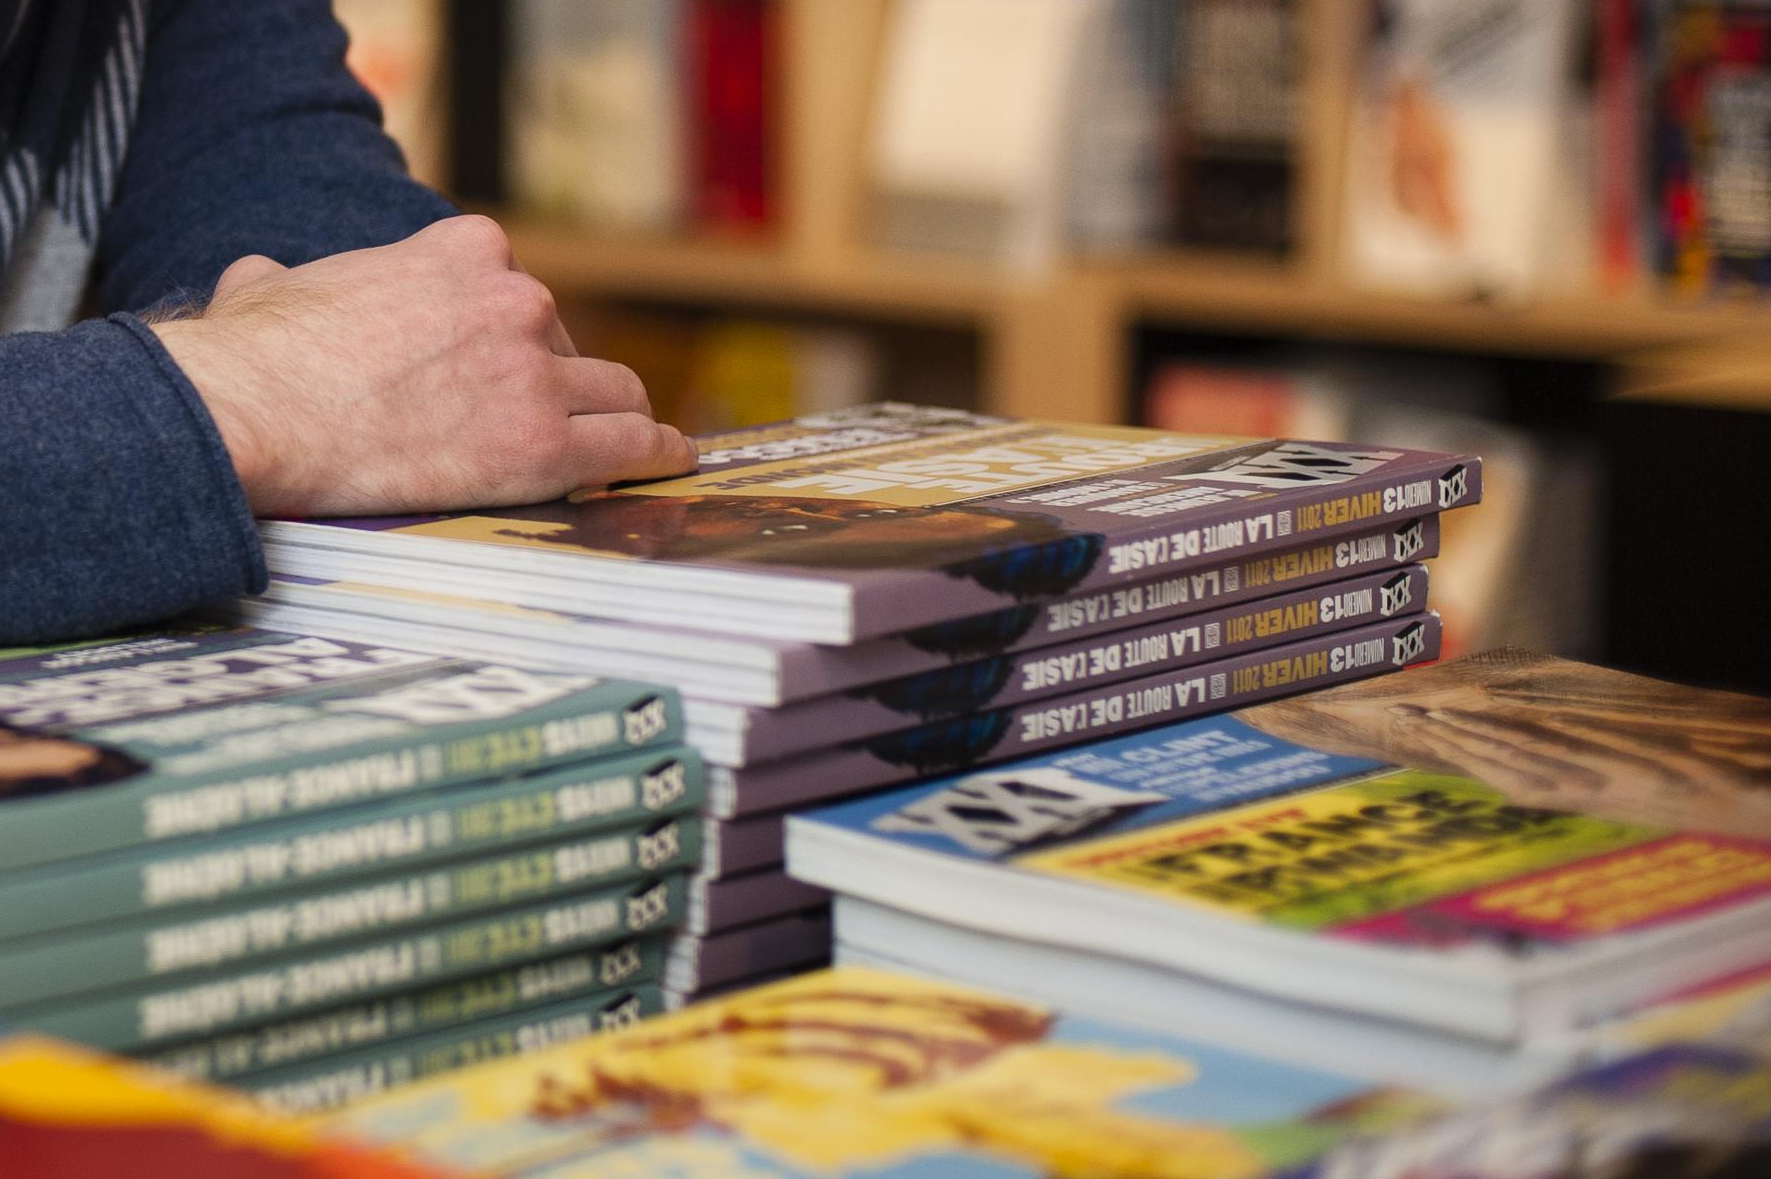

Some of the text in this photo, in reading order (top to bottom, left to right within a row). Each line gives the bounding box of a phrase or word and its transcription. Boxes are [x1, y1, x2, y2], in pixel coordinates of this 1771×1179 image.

[1438, 467, 1467, 508] XXI
[1297, 505, 1321, 531] 2011
[1324, 491, 1381, 525] HIVER
[1203, 521, 1242, 553] ROUTE
[1246, 514, 1273, 543] LA
[1394, 522, 1423, 563] XXI
[1108, 537, 1168, 573] L'ASIE
[1171, 531, 1199, 560] DE
[1245, 556, 1271, 584] 2011
[1273, 546, 1333, 582] HIVER
[1146, 577, 1188, 609] ROUTE
[1191, 571, 1220, 599] LA
[1380, 575, 1411, 616] XXI
[1047, 593, 1109, 631] L'ASIE
[1112, 587, 1143, 616] DE
[1227, 616, 1252, 644] 2011
[1254, 600, 1318, 637] HIVER
[1124, 634, 1168, 667] ROUTE
[1170, 627, 1200, 655] LA
[1393, 624, 1425, 665] XXI
[1022, 653, 1087, 690] L'ASIE
[1090, 645, 1121, 675] DE
[1262, 650, 1327, 688] HIVER
[1175, 678, 1205, 706] LA
[1233, 666, 1260, 694] 2011
[1091, 695, 1123, 726] DE
[1127, 684, 1172, 719] ROUTE
[1021, 703, 1087, 742] L'ASIE
